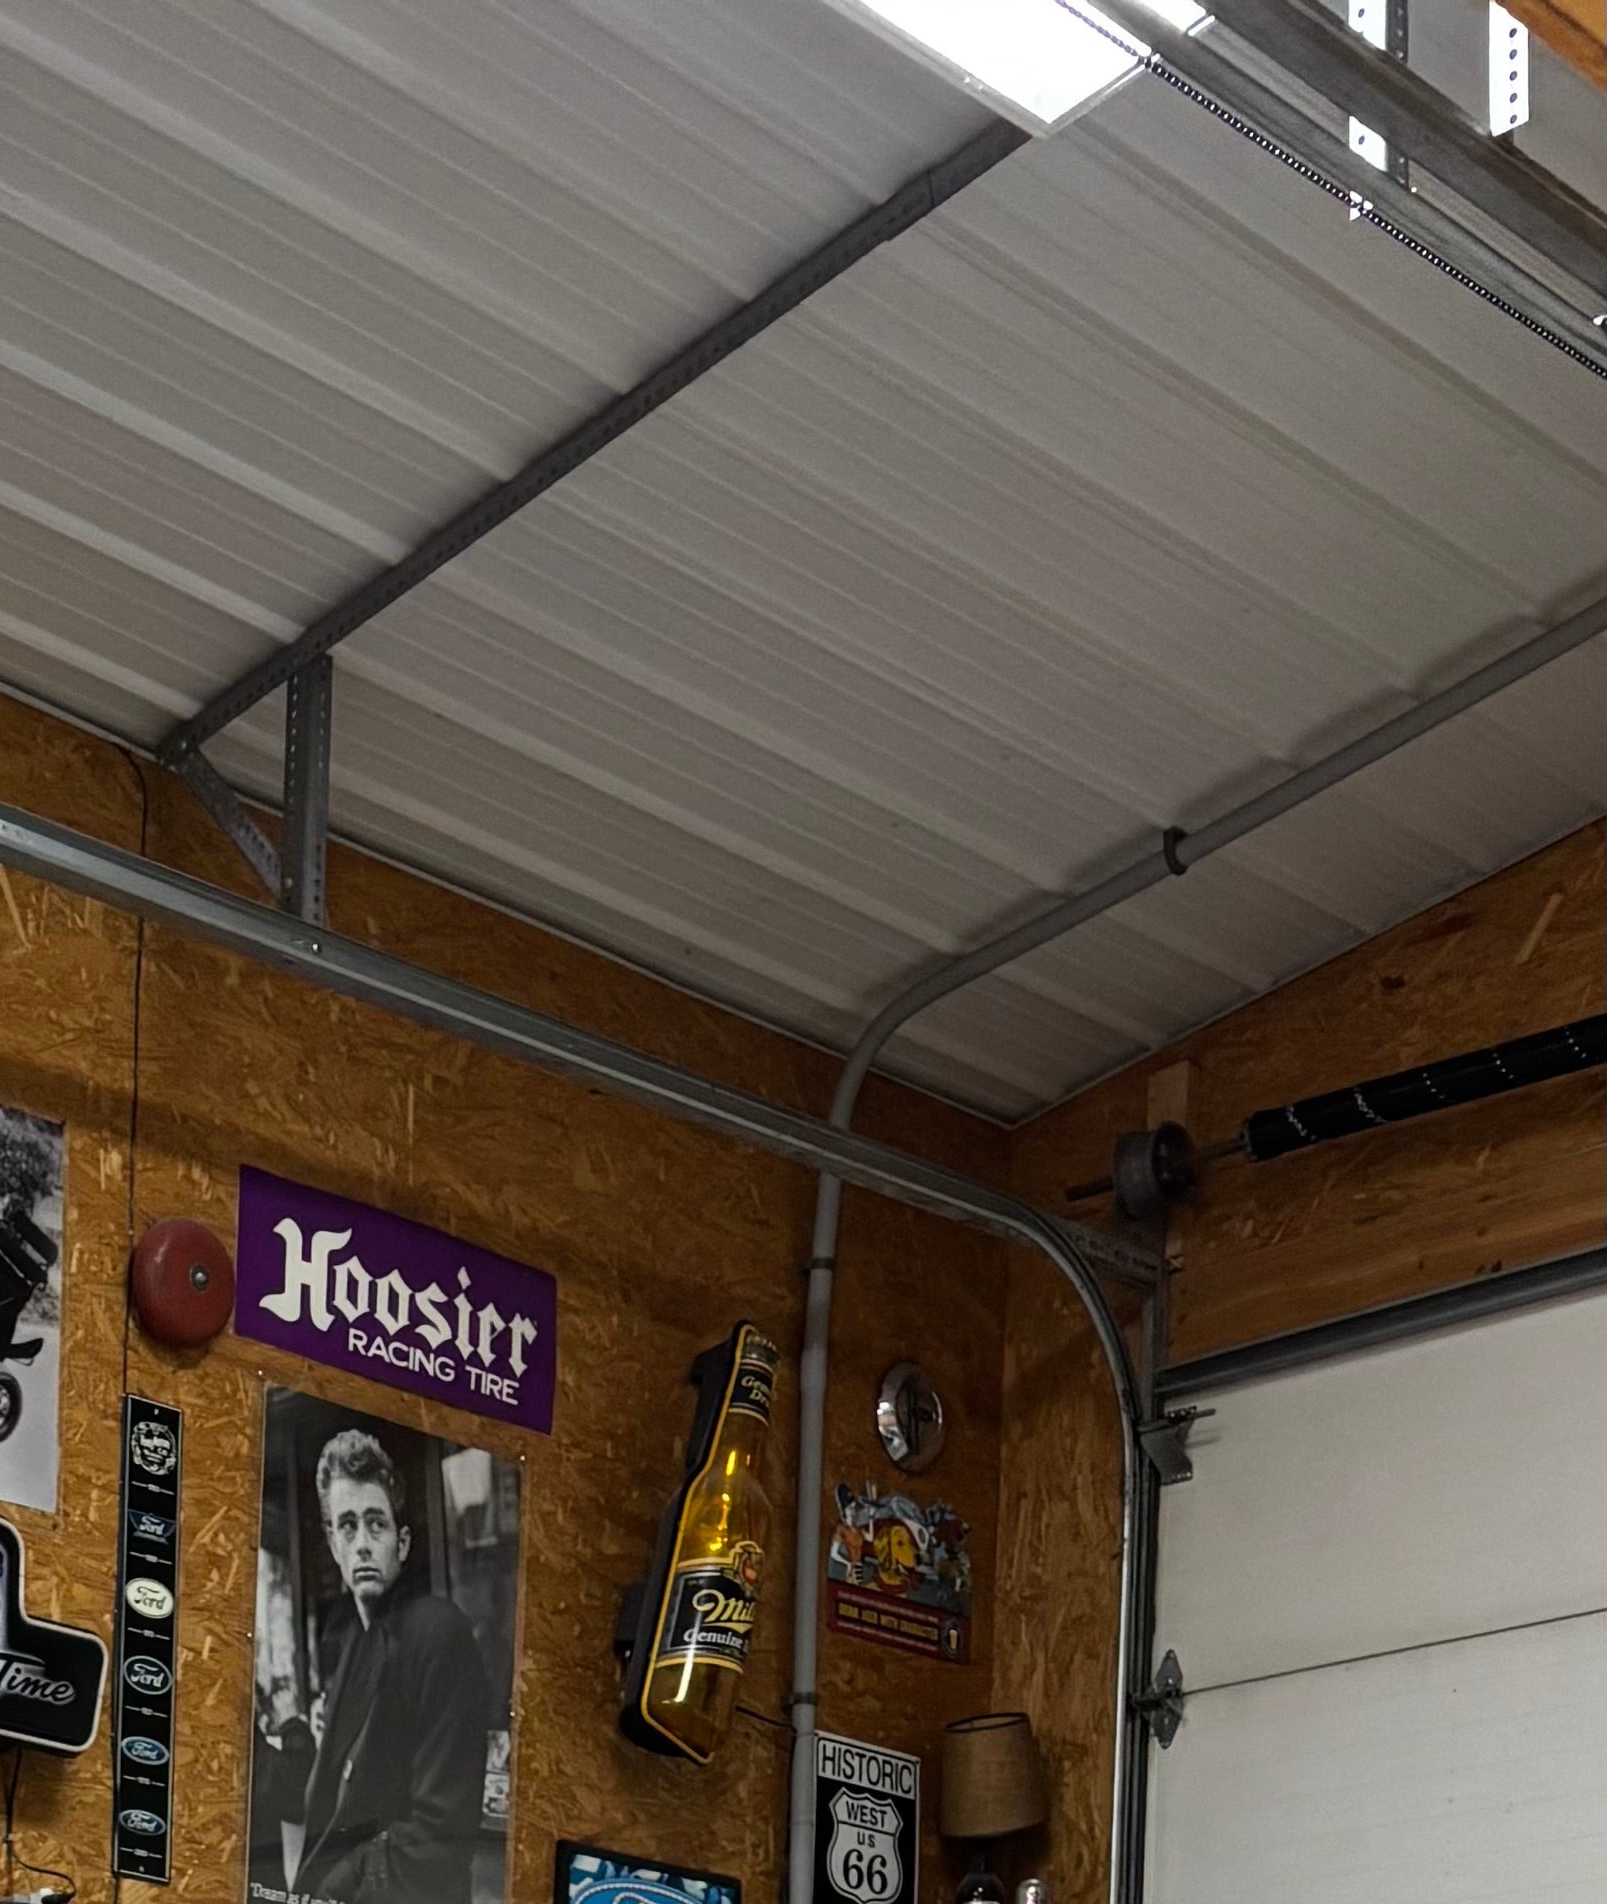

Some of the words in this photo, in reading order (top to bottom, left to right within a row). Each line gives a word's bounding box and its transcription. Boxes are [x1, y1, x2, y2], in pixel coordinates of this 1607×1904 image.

[259, 1217, 537, 1378] Hoosier
[348, 1328, 456, 1382] RACING
[465, 1365, 520, 1406] TIRE
[134, 1585, 166, 1610] Ford
[130, 1663, 165, 1688] Ford
[822, 1743, 913, 1795] HISTORIC
[846, 1800, 887, 1829] WEST
[843, 1849, 888, 1895] 66
